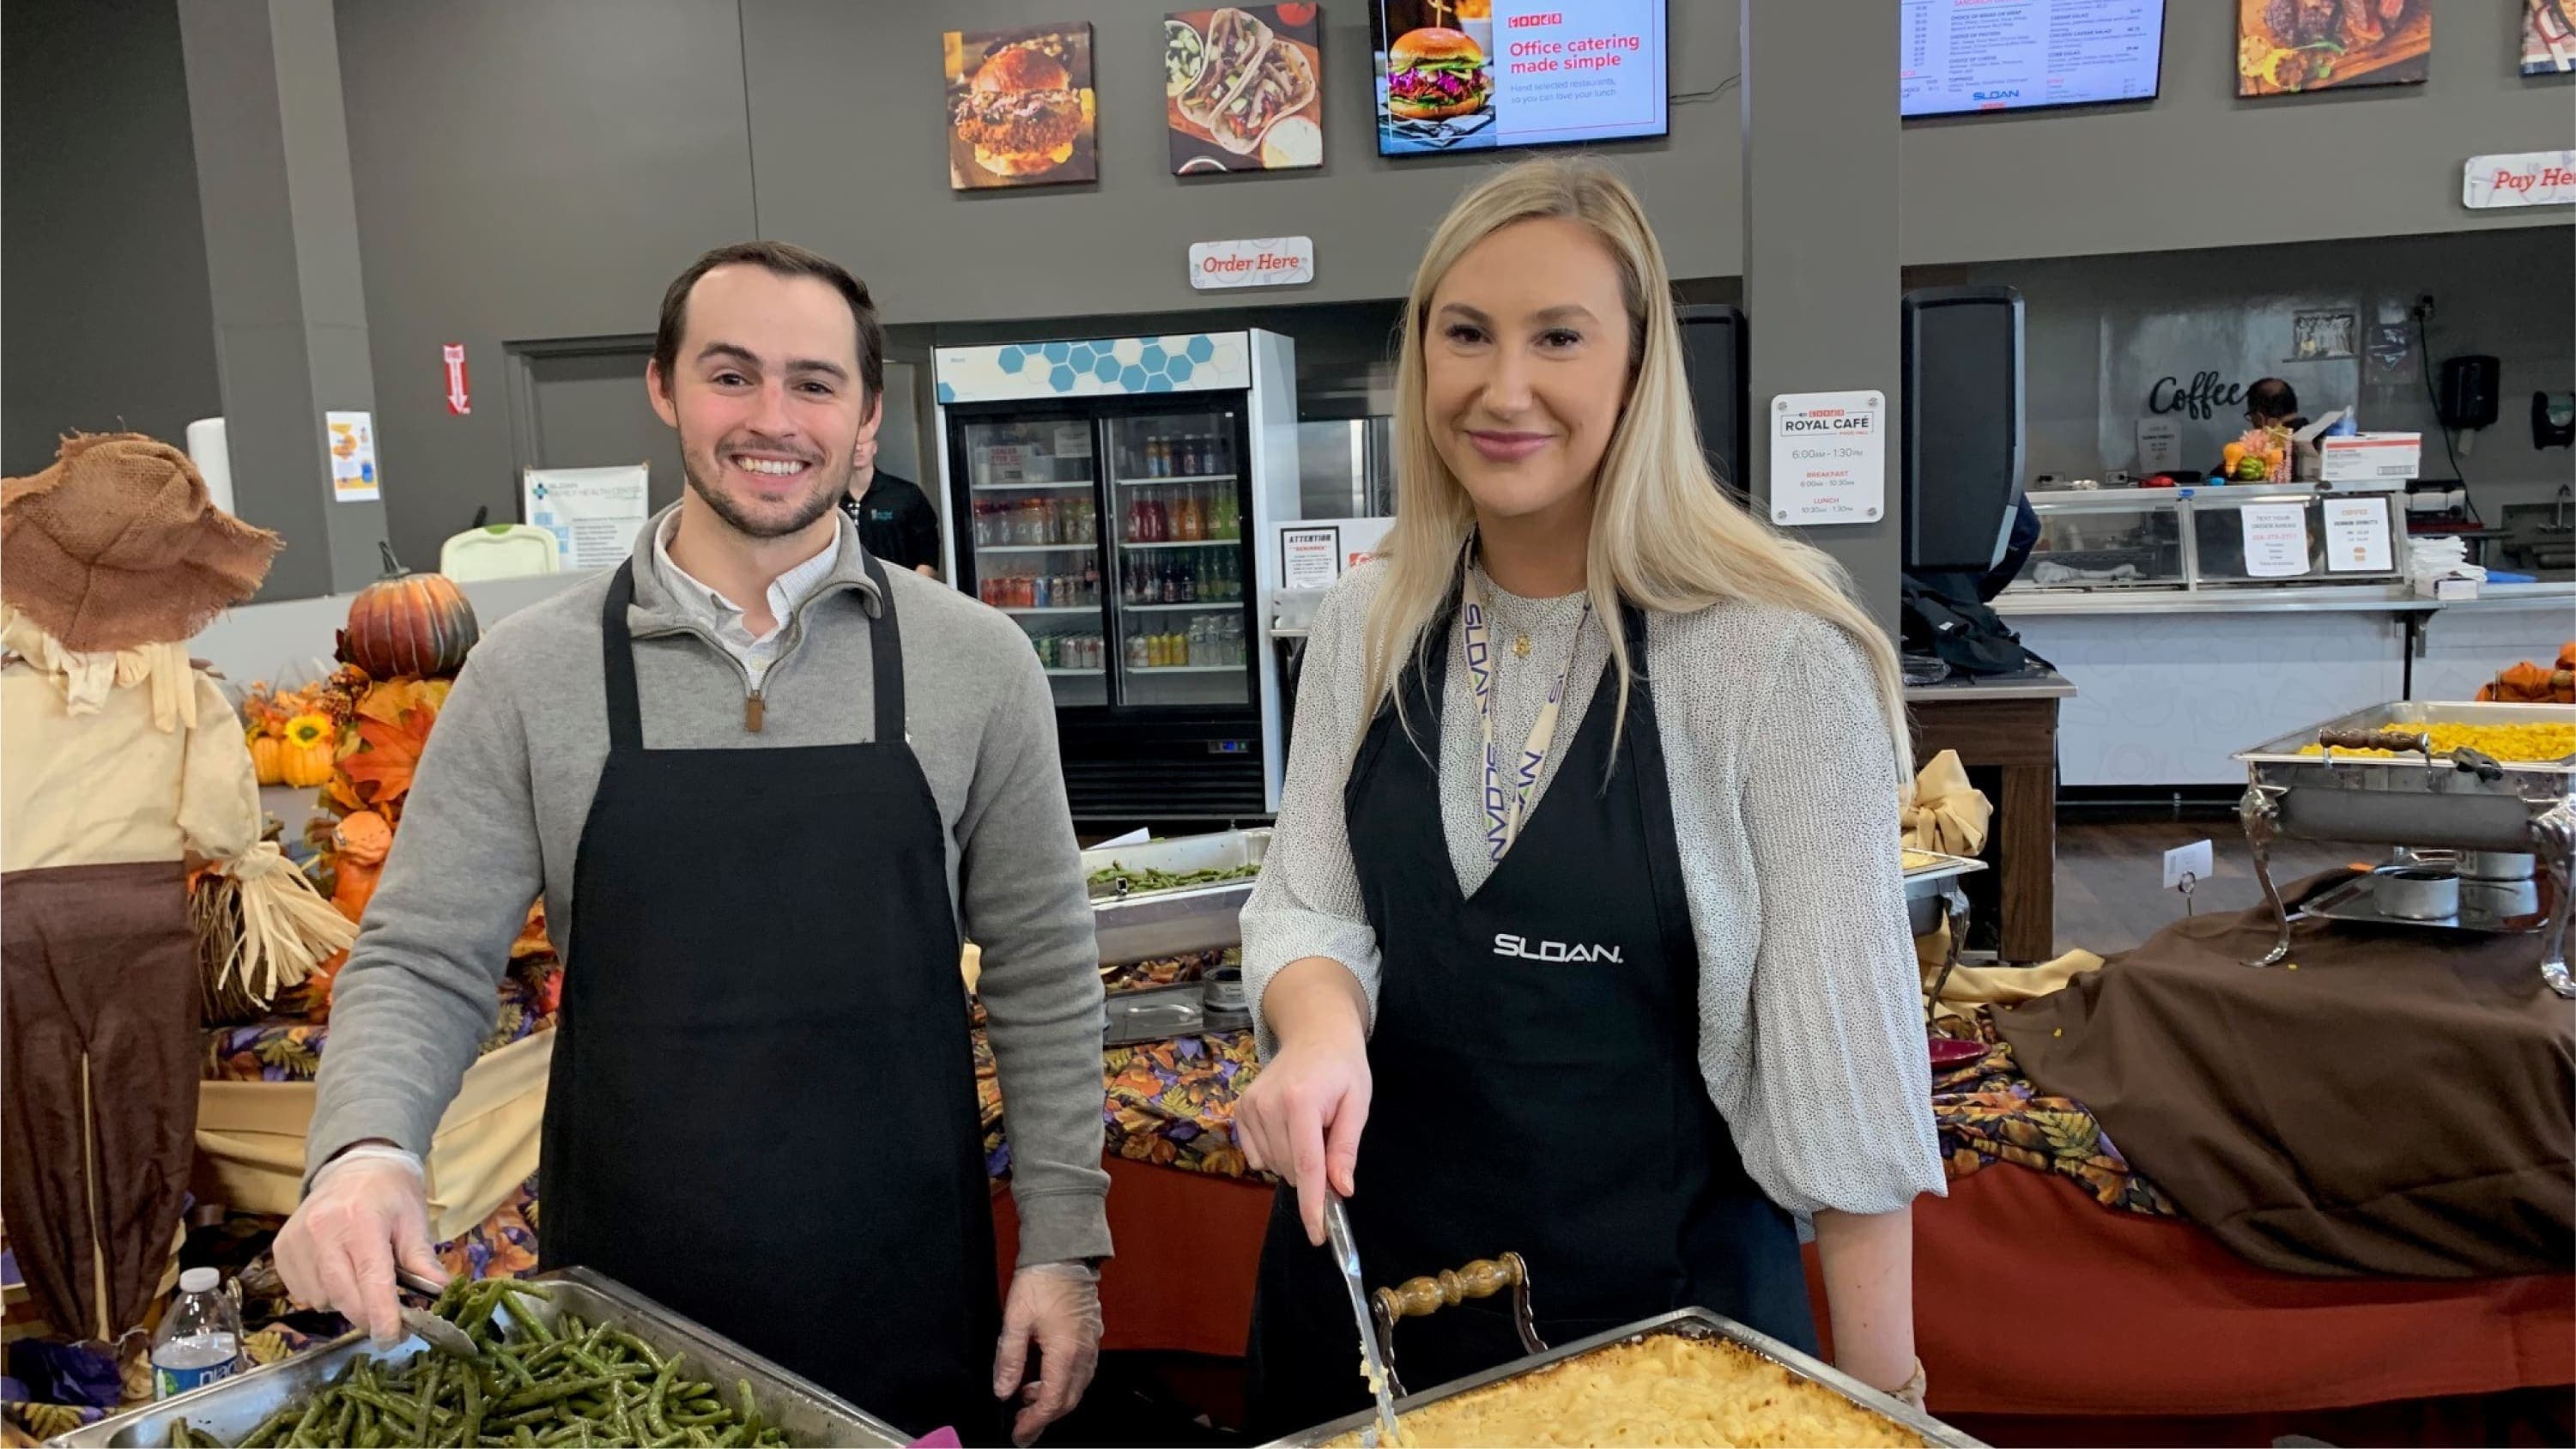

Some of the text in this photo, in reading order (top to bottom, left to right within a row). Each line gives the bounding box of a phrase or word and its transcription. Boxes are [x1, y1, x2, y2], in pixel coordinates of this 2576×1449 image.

[1510, 33, 1640, 57] Office catering
[1511, 52, 1621, 74] made simple
[1534, 81, 1568, 90] selected
[1973, 89, 2020, 100] SLOAN
[1523, 96, 1537, 105] you
[1574, 91, 1592, 100] your
[1595, 88, 1616, 97] lunch
[2494, 170, 2537, 192] Pay
[1203, 252, 1300, 273] Order Here
[2149, 371, 2248, 421] Coffee
[1785, 415, 1870, 432] ROYAL CAFÉ
[1289, 534, 1331, 543] ATTENTION
